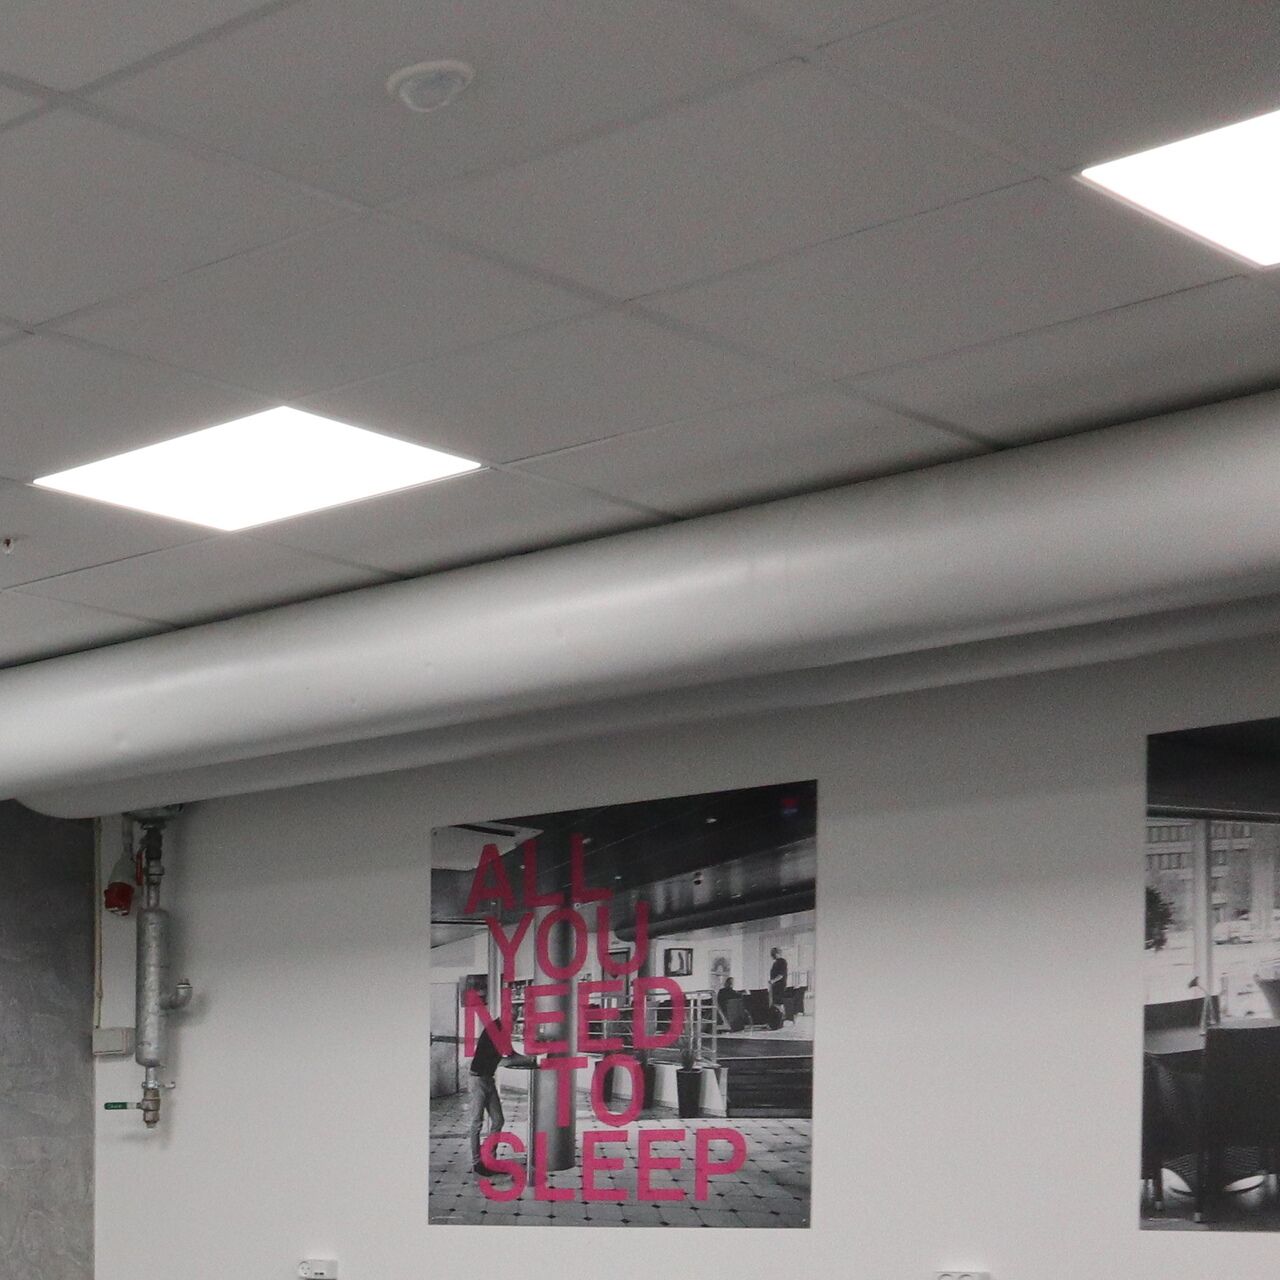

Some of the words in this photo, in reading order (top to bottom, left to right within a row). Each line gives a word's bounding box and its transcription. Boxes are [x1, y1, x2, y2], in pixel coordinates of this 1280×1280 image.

[463, 832, 615, 913] ALL
[485, 902, 651, 984] YOU
[463, 976, 687, 1058] NEED
[540, 1051, 646, 1129] TO
[477, 1126, 749, 1203] SLEEP
